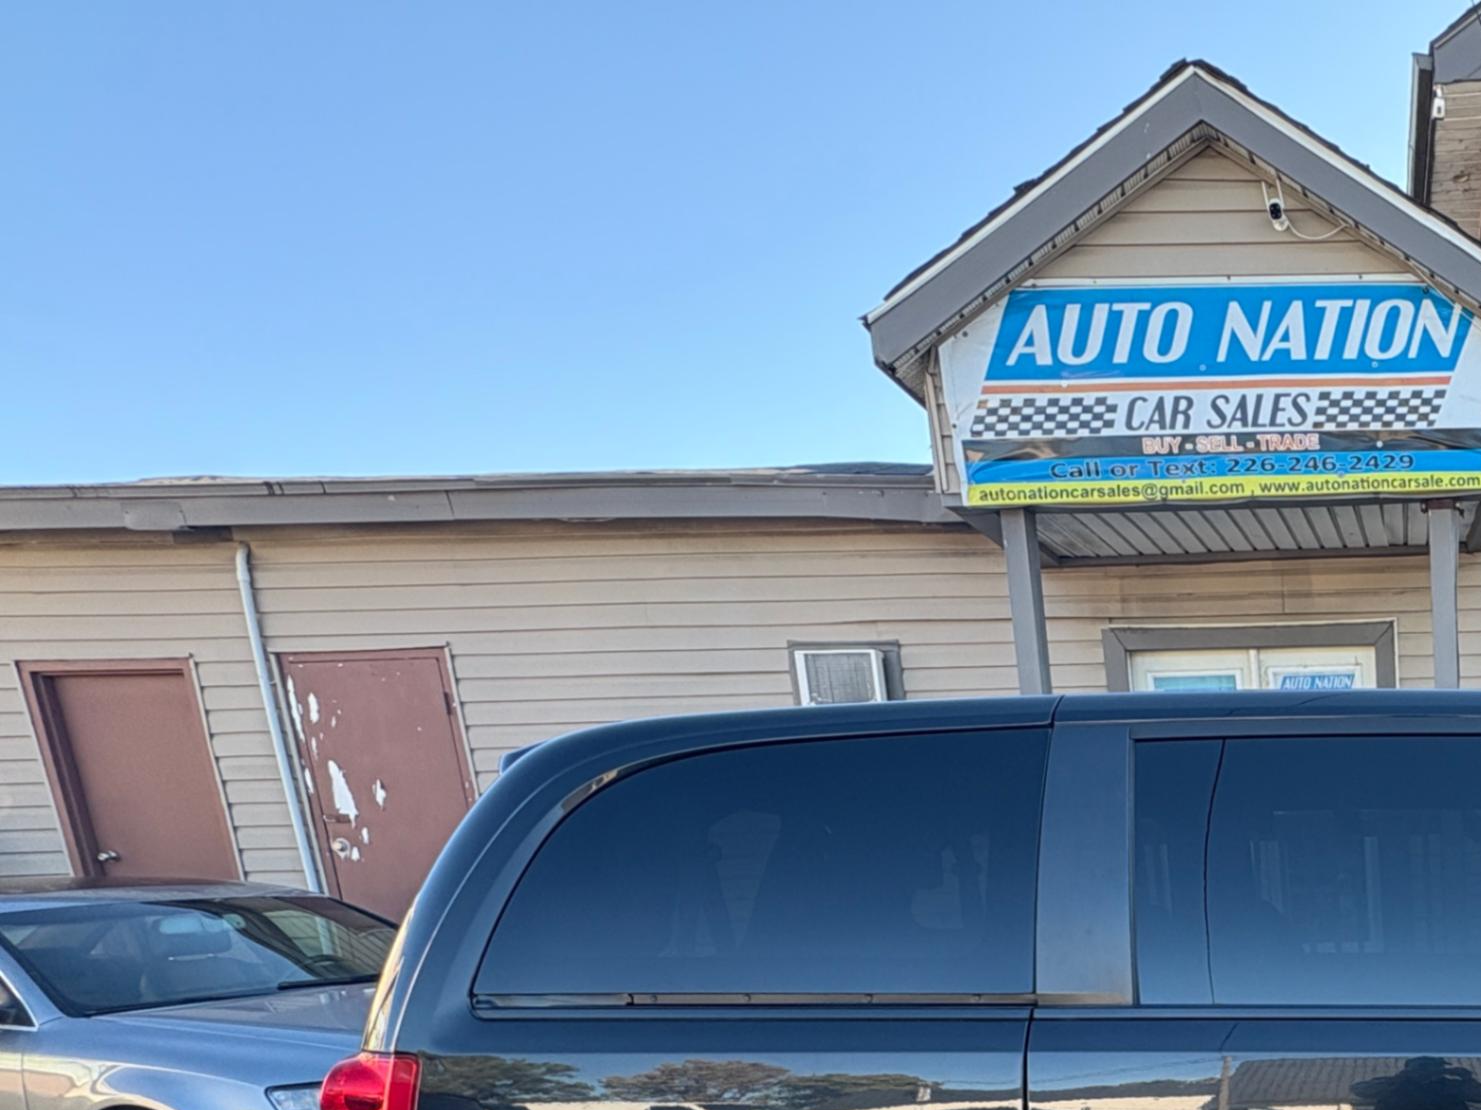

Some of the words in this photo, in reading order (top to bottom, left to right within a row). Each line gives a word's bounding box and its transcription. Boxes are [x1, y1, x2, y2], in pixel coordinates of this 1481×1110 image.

[1005, 301, 1194, 366] AUTO
[1216, 299, 1462, 362] NATION
[1125, 395, 1194, 431] CAR
[1206, 393, 1311, 429] SALES
[1142, 437, 1181, 455] BUY
[1196, 435, 1243, 452] SELL
[1257, 433, 1320, 451] TRADE
[1050, 461, 1101, 479] Call
[1110, 463, 1138, 477] or
[1148, 458, 1217, 476] Text:
[1227, 454, 1415, 473] 226-246-2429
[979, 480, 1246, 503] autonationcarsales@gmail.com
[1259, 474, 1481, 493] www.autonationcarsale.com
[1283, 677, 1311, 690] AUTO
[1314, 675, 1352, 689] NATION
